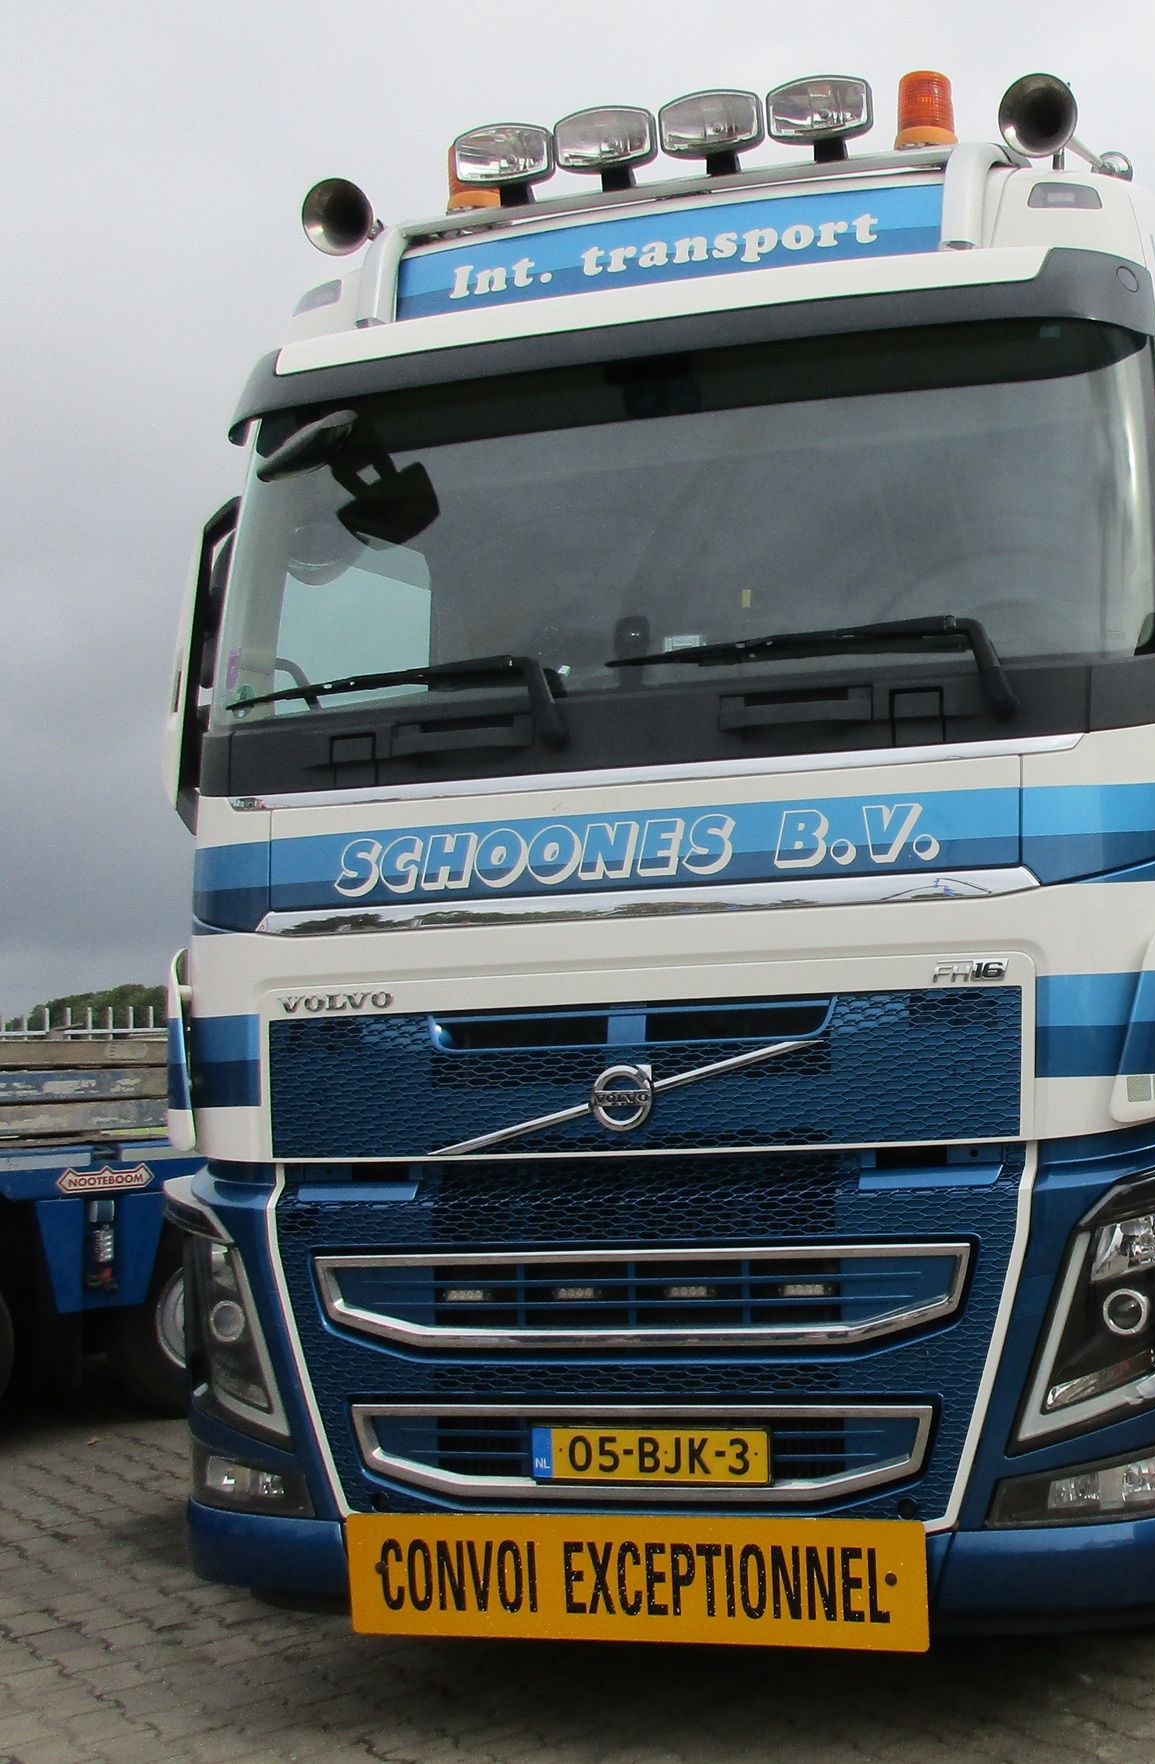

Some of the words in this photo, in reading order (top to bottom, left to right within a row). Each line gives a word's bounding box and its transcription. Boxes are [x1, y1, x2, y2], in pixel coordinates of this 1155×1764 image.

[449, 257, 553, 299] Int.
[580, 213, 879, 277] transport
[333, 813, 736, 898] SCHOONES
[774, 802, 942, 870] B.V.
[932, 960, 1006, 983] FH16
[278, 991, 394, 1014] VOLVO
[68, 1173, 144, 1188] NOOTEBOOM
[535, 1457, 551, 1469] NL
[568, 1435, 750, 1475] 05-BJK-3
[381, 1538, 537, 1614] CONVOI
[564, 1540, 891, 1625] EXCEPTIONNEL
